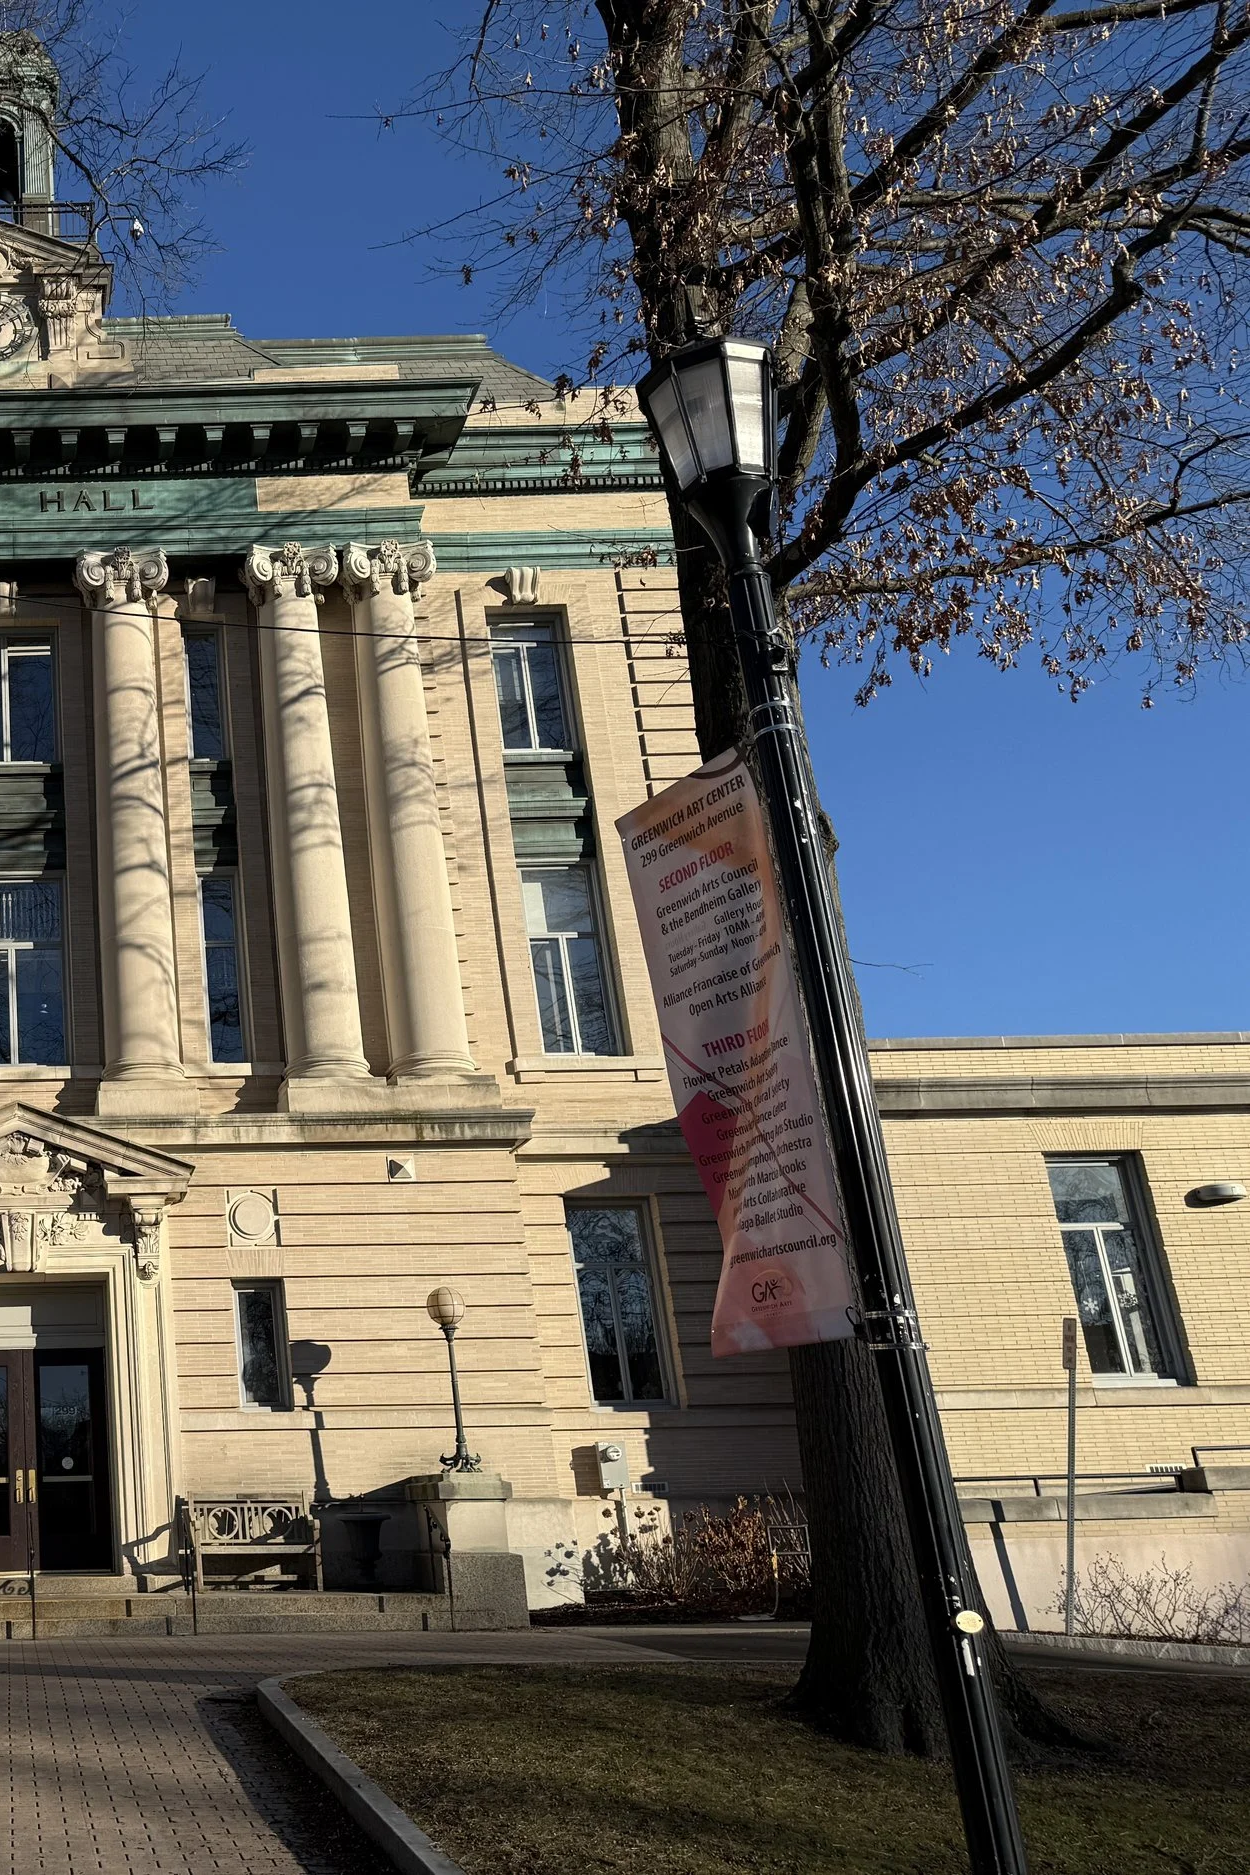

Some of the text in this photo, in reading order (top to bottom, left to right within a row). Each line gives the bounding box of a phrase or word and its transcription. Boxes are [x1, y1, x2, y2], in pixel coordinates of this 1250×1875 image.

[38, 487, 156, 512] HALL
[631, 774, 745, 851] GREENWICH ART CENTER
[640, 802, 744, 868] 299 Greenwich Avenue
[658, 841, 734, 893] SECOND FLOOR
[656, 857, 759, 919] Greenwich Arts Council
[661, 880, 762, 935] & the Bendheim Gallery
[713, 905, 745, 926] Gallery
[668, 944, 694, 964] Tuesday
[697, 931, 721, 949] Friday
[723, 919, 750, 936] 10AM
[669, 957, 697, 978] Saturday
[699, 943, 728, 962] Sunday
[730, 934, 755, 949] Noon
[663, 987, 693, 1009] Alliance
[740, 961, 752, 976] of
[751, 941, 781, 971] Greenwich
[689, 1000, 714, 1017] Open
[714, 990, 739, 1007] Arts
[702, 1018, 770, 1058] THIRD FLOOR
[683, 1071, 717, 1089] Flower
[717, 1059, 750, 1078] Petals
[707, 1077, 756, 1102] Greenwich
[701, 1098, 753, 1125] Greenwich
[716, 1118, 755, 1141] Greenwi
[699, 1142, 746, 1167] Greenwich
[783, 1113, 814, 1132] Studio
[712, 1163, 749, 1184] Greenwi
[749, 1148, 776, 1169] mphony
[758, 1182, 807, 1206] Collaborative
[754, 1211, 777, 1227] Ballet
[776, 1203, 804, 1220] Studio
[729, 1233, 838, 1269] greenwichartscouncil.org
